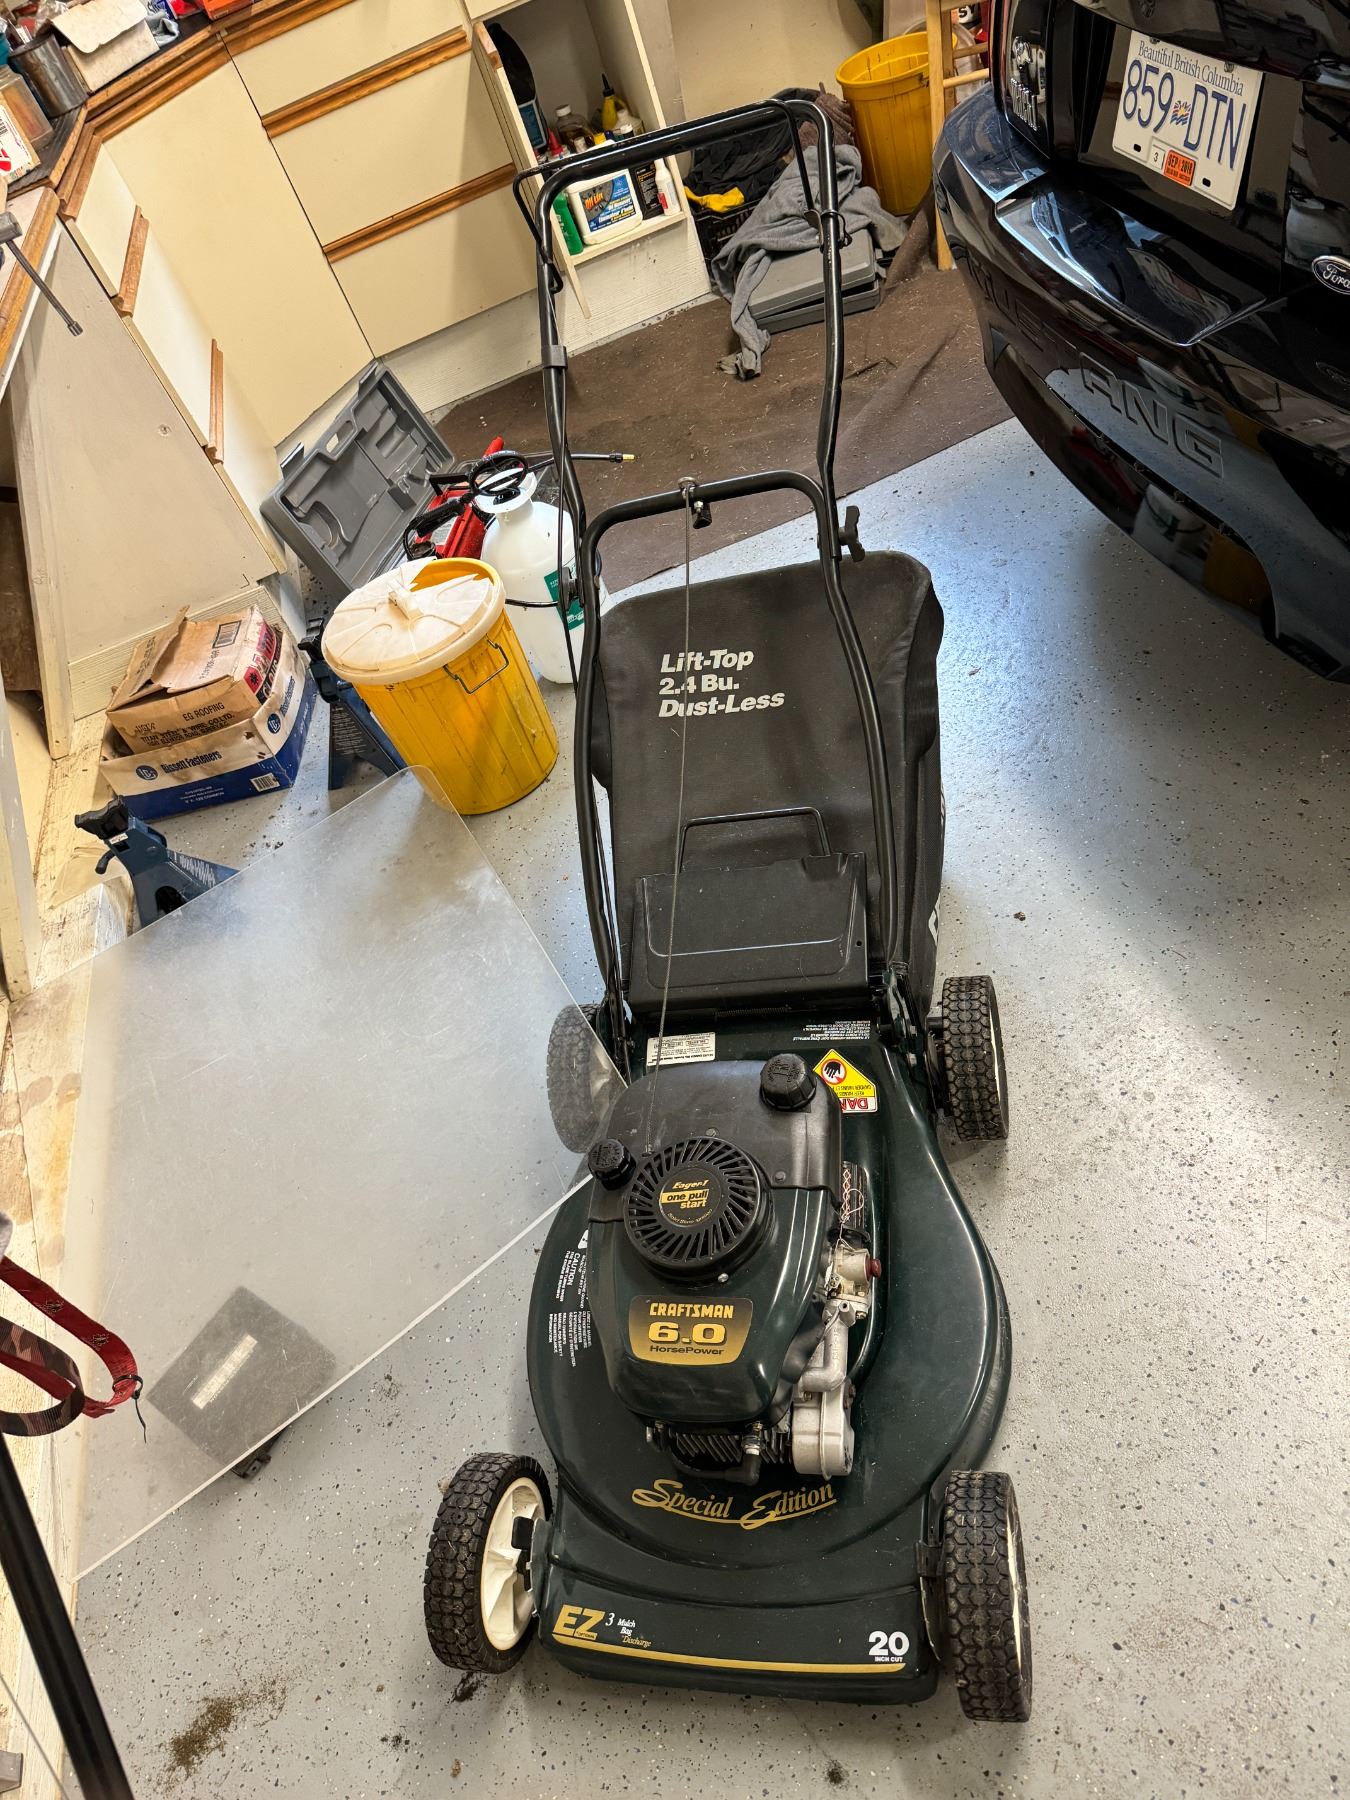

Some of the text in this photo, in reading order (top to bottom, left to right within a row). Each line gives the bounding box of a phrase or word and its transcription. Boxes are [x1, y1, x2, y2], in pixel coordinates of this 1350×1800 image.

[1138, 40, 1243, 96] Beautiful British Columbia
[1123, 59, 1175, 133] 859
[1183, 83, 1247, 171] DTN
[1153, 151, 1159, 162] 3
[660, 648, 754, 673] Lift-Top
[659, 673, 740, 695] 2.4 Bu.
[194, 701, 225, 718] ROOFING
[658, 692, 785, 717] Dust-Less
[185, 750, 223, 770] Fasteners
[841, 1097, 868, 1110] DAN
[667, 1190, 708, 1202] one pull
[680, 1200, 707, 1209] start
[567, 1253, 580, 1285] CAUTION
[649, 1302, 734, 1319] CRAFTSMAN
[648, 1321, 727, 1344] 6.0
[649, 1345, 725, 1355] HorsePower
[632, 1479, 837, 1530] Special Edition
[552, 1604, 636, 1640] EZ 3 Mulch
[620, 1626, 633, 1637] Bag
[868, 1630, 910, 1656] 20
